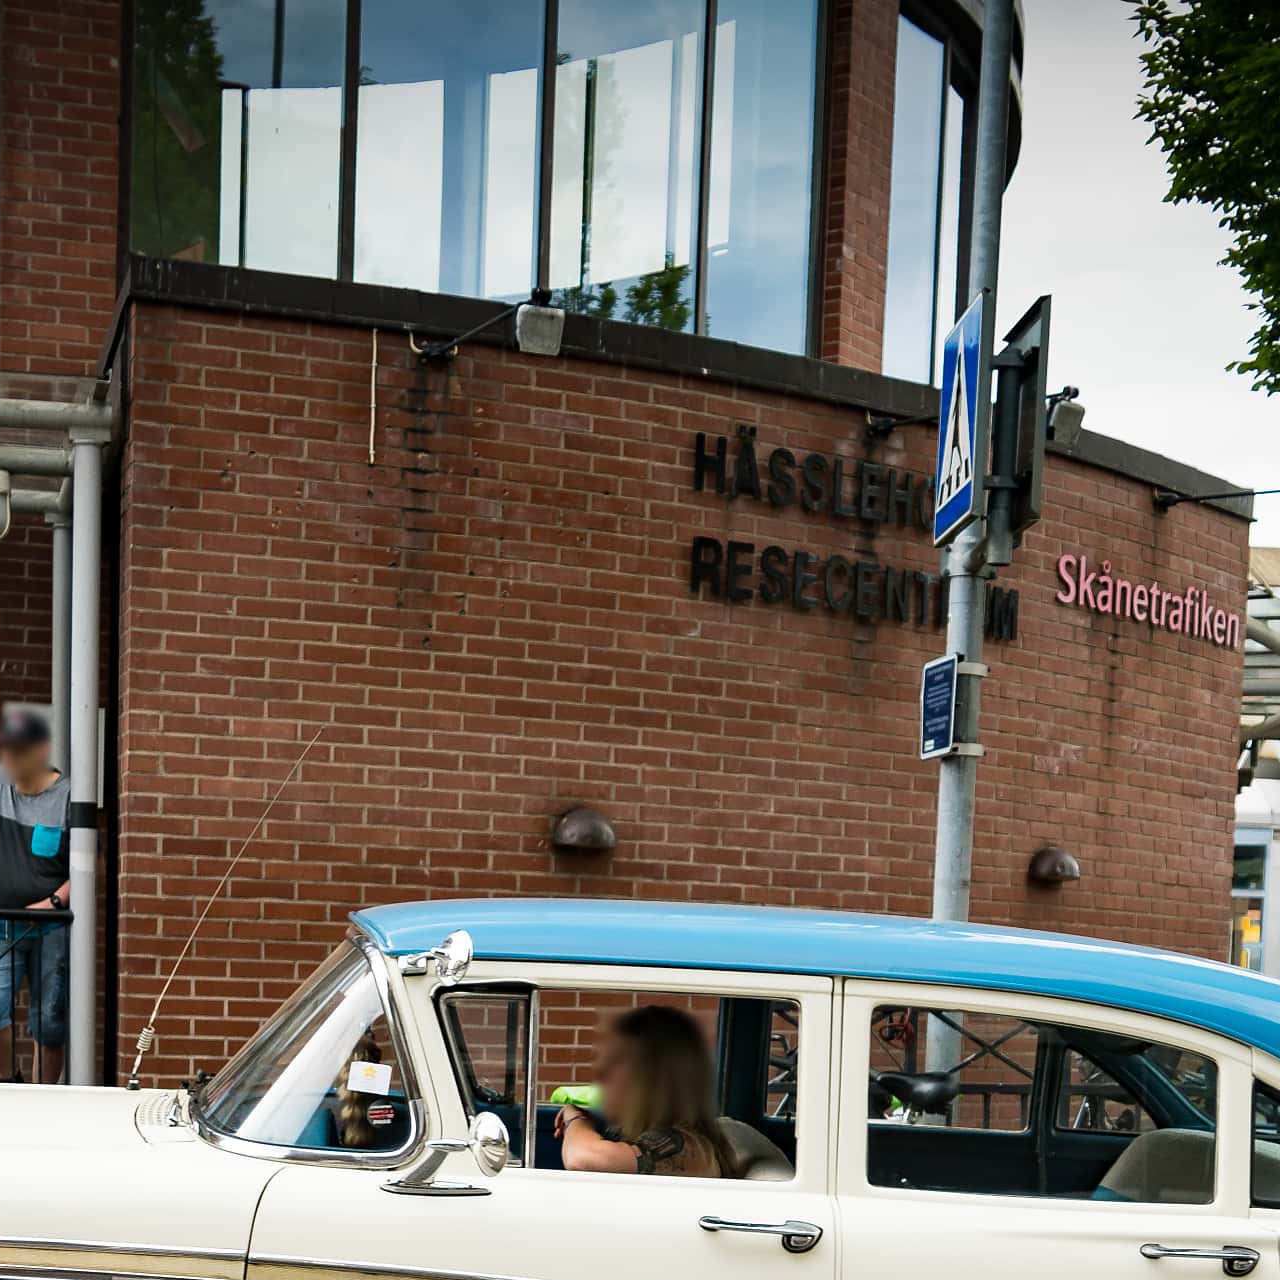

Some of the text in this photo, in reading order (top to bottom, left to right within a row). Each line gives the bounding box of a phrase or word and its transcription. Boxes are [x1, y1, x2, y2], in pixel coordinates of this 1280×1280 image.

[694, 424, 936, 530] HÄSSLEHO
[688, 535, 1019, 641] RESECENTM
[1056, 554, 1240, 649] Skånetrafiken
